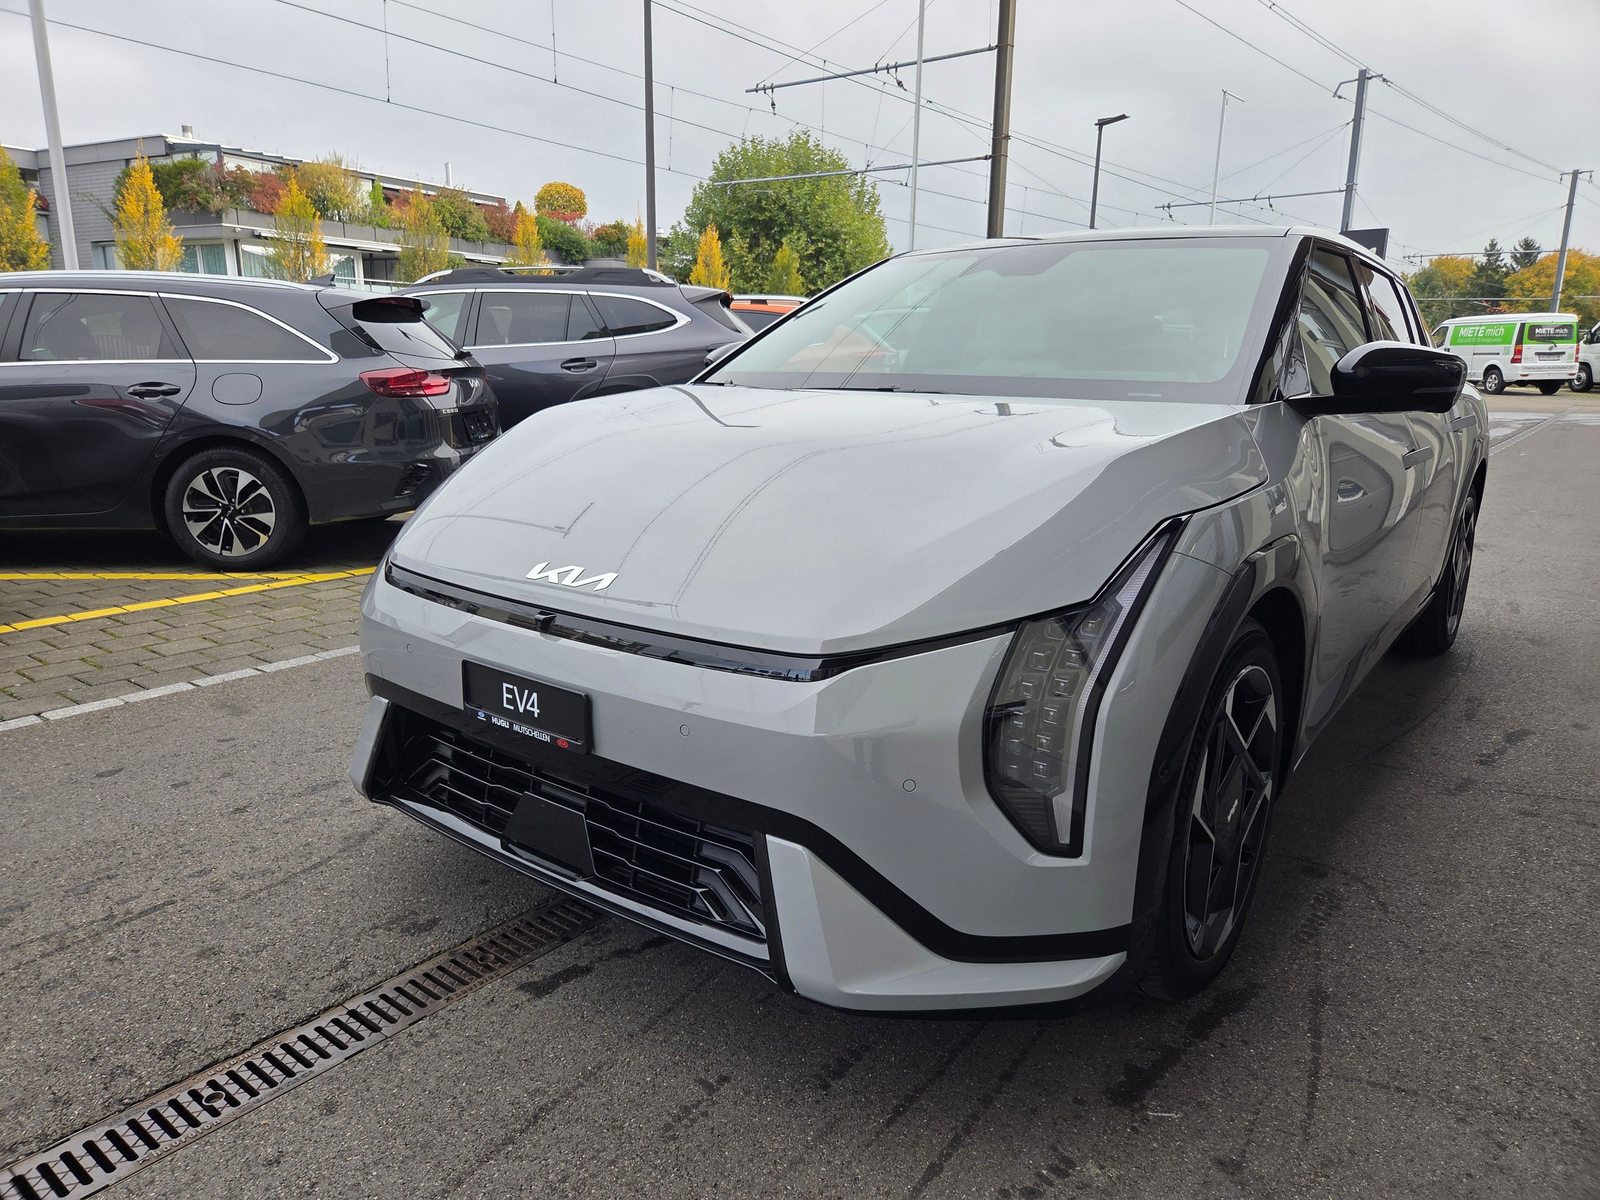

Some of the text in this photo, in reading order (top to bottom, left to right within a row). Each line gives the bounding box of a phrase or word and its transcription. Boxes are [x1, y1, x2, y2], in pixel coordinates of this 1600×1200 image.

[1459, 325, 1504, 337] MIETE mich
[525, 561, 619, 592] KIA
[502, 682, 540, 718] EV4
[512, 723, 551, 743] MUTSCHELLEN
